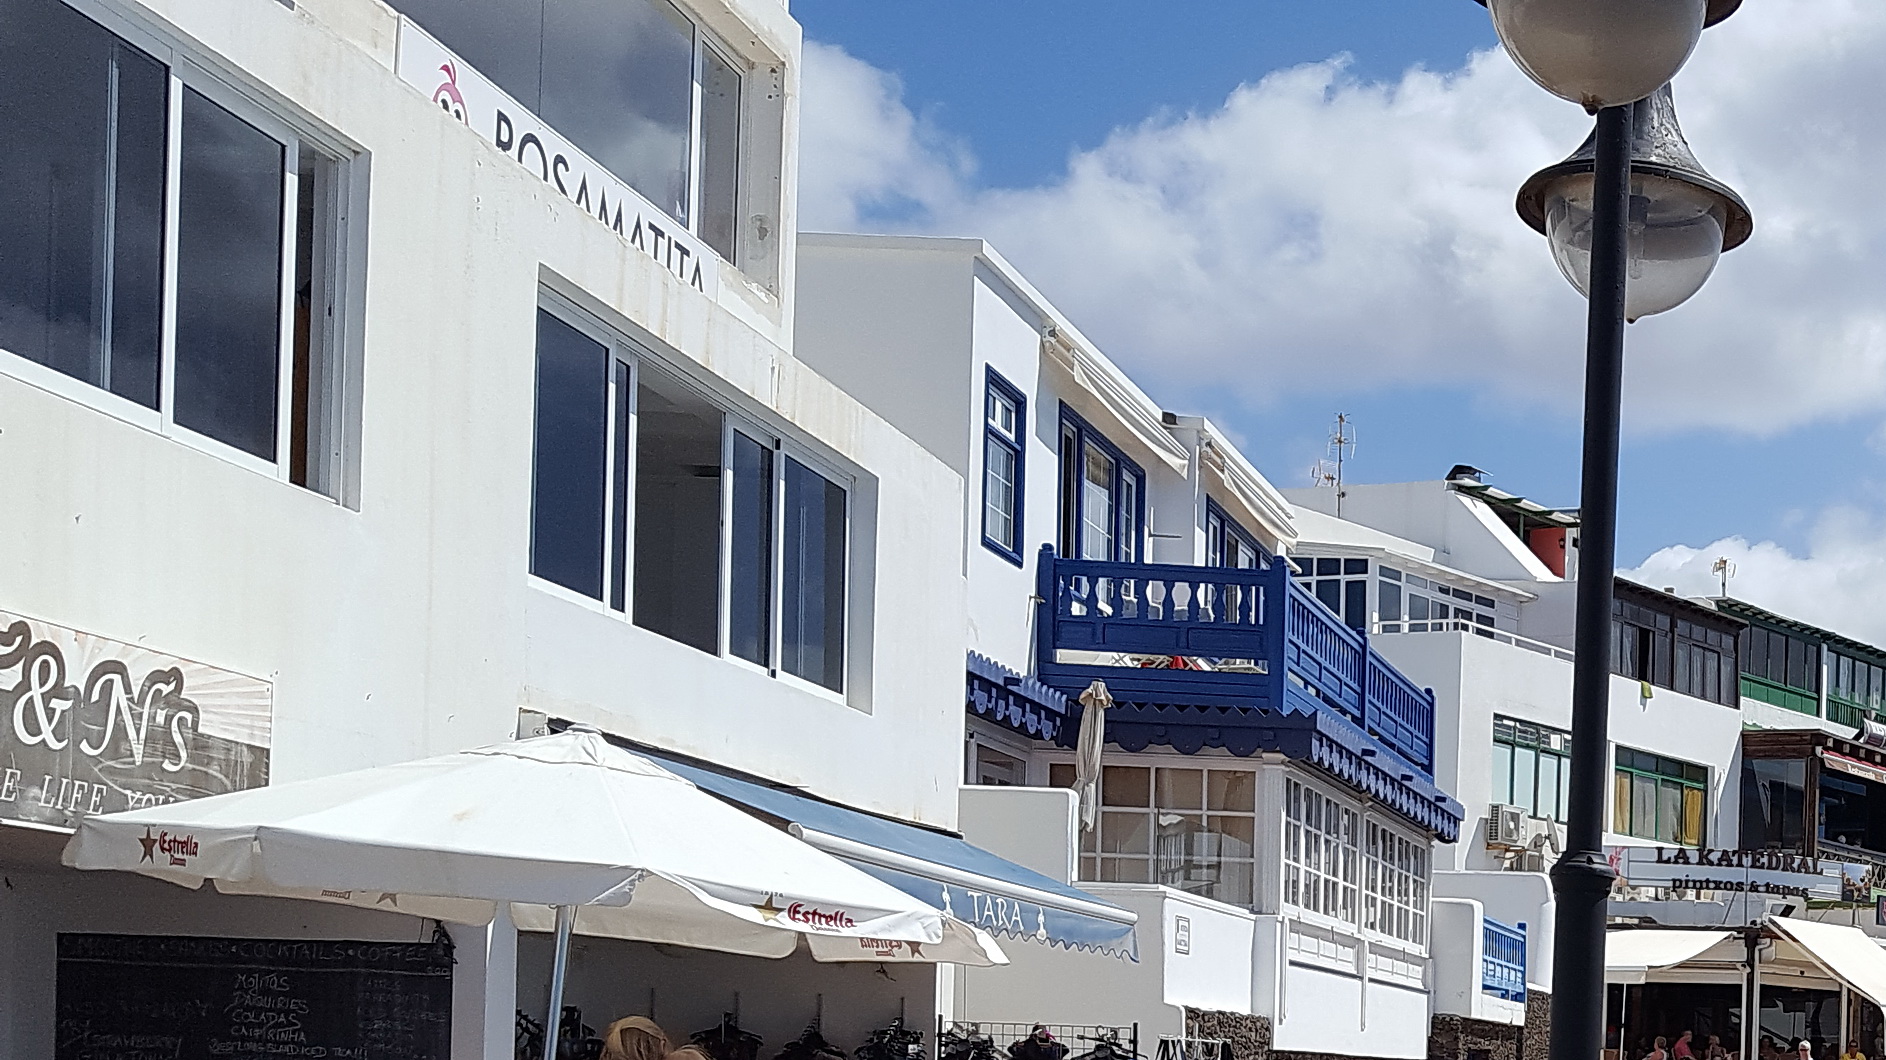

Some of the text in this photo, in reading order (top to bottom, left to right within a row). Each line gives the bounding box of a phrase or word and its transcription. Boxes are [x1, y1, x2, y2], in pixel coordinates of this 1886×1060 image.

[38, 774, 108, 816] LIFE
[158, 830, 199, 859] Estrella
[1655, 846, 1824, 876] LA KATEDRAL
[1671, 873, 1745, 893] pintxos
[786, 900, 857, 929] Estrella
[967, 890, 1025, 932] TARA
[240, 943, 346, 961] COCKTAILS
